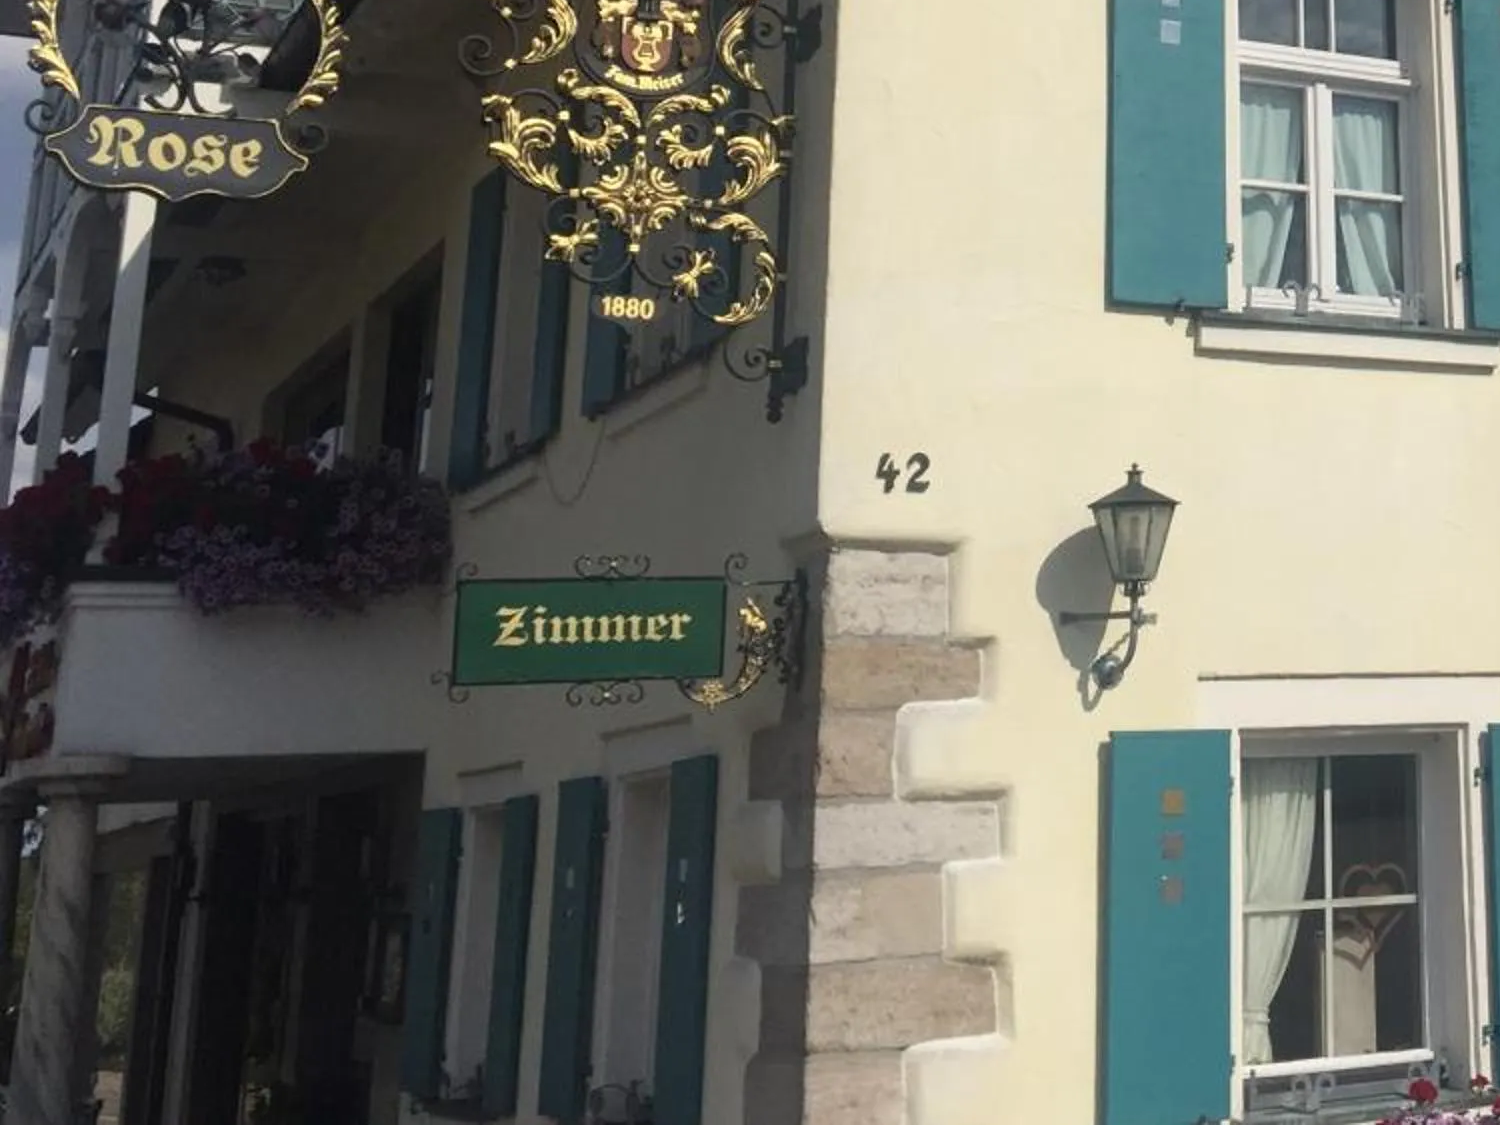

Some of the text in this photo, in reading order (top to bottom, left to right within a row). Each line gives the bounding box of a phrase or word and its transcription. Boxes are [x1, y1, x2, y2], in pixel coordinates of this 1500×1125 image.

[86, 116, 263, 177] Rose
[601, 296, 655, 320] 1880
[875, 452, 931, 494] 42
[493, 605, 692, 646] Zimmer
